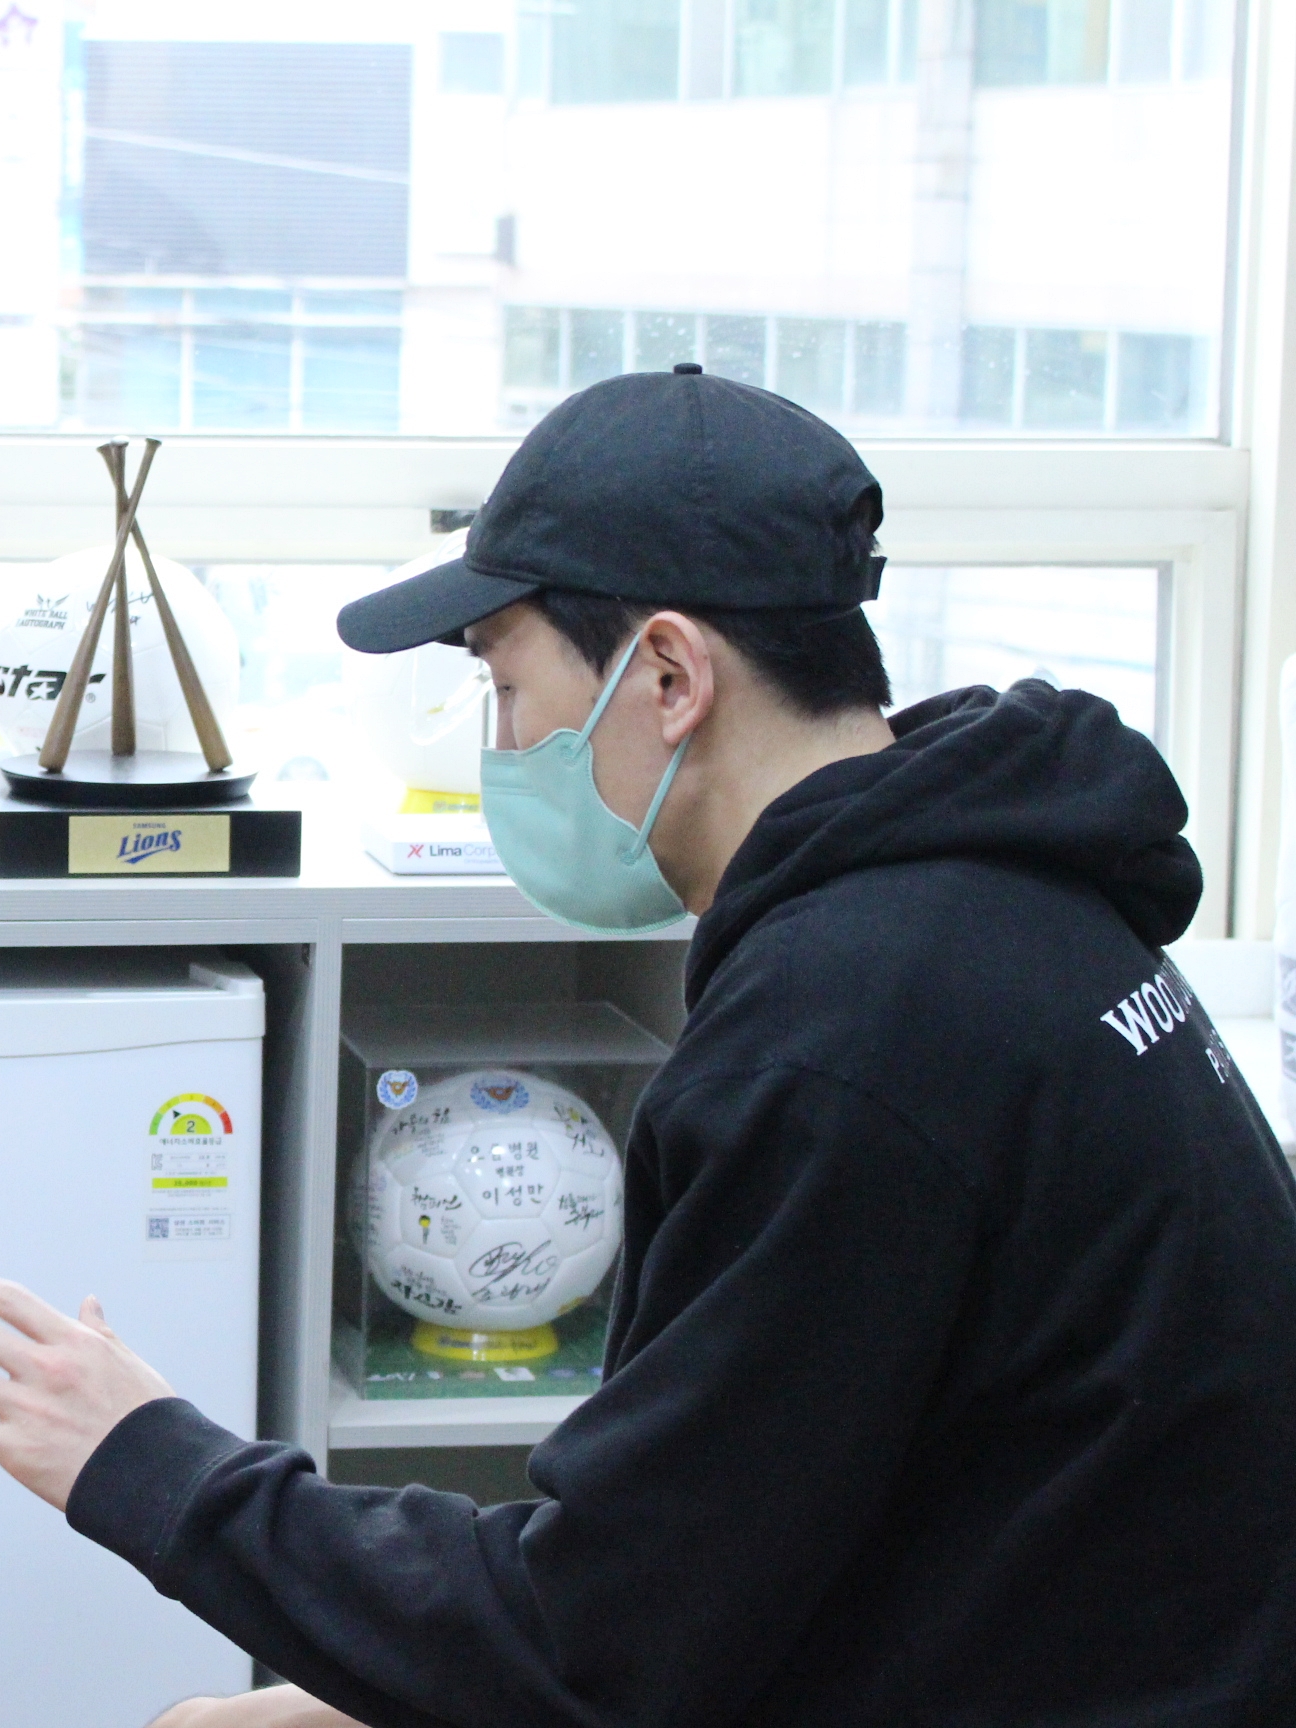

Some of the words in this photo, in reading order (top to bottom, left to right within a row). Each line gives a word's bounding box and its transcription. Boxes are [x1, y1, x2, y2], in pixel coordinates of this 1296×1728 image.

[23, 609, 48, 618] WHITE
[48, 610, 68, 620] BALL
[117, 830, 182, 859] Lions
[1100, 960, 1193, 1056] WOO
[186, 1120, 195, 1133] 2
[482, 1183, 544, 1206] 이성만
